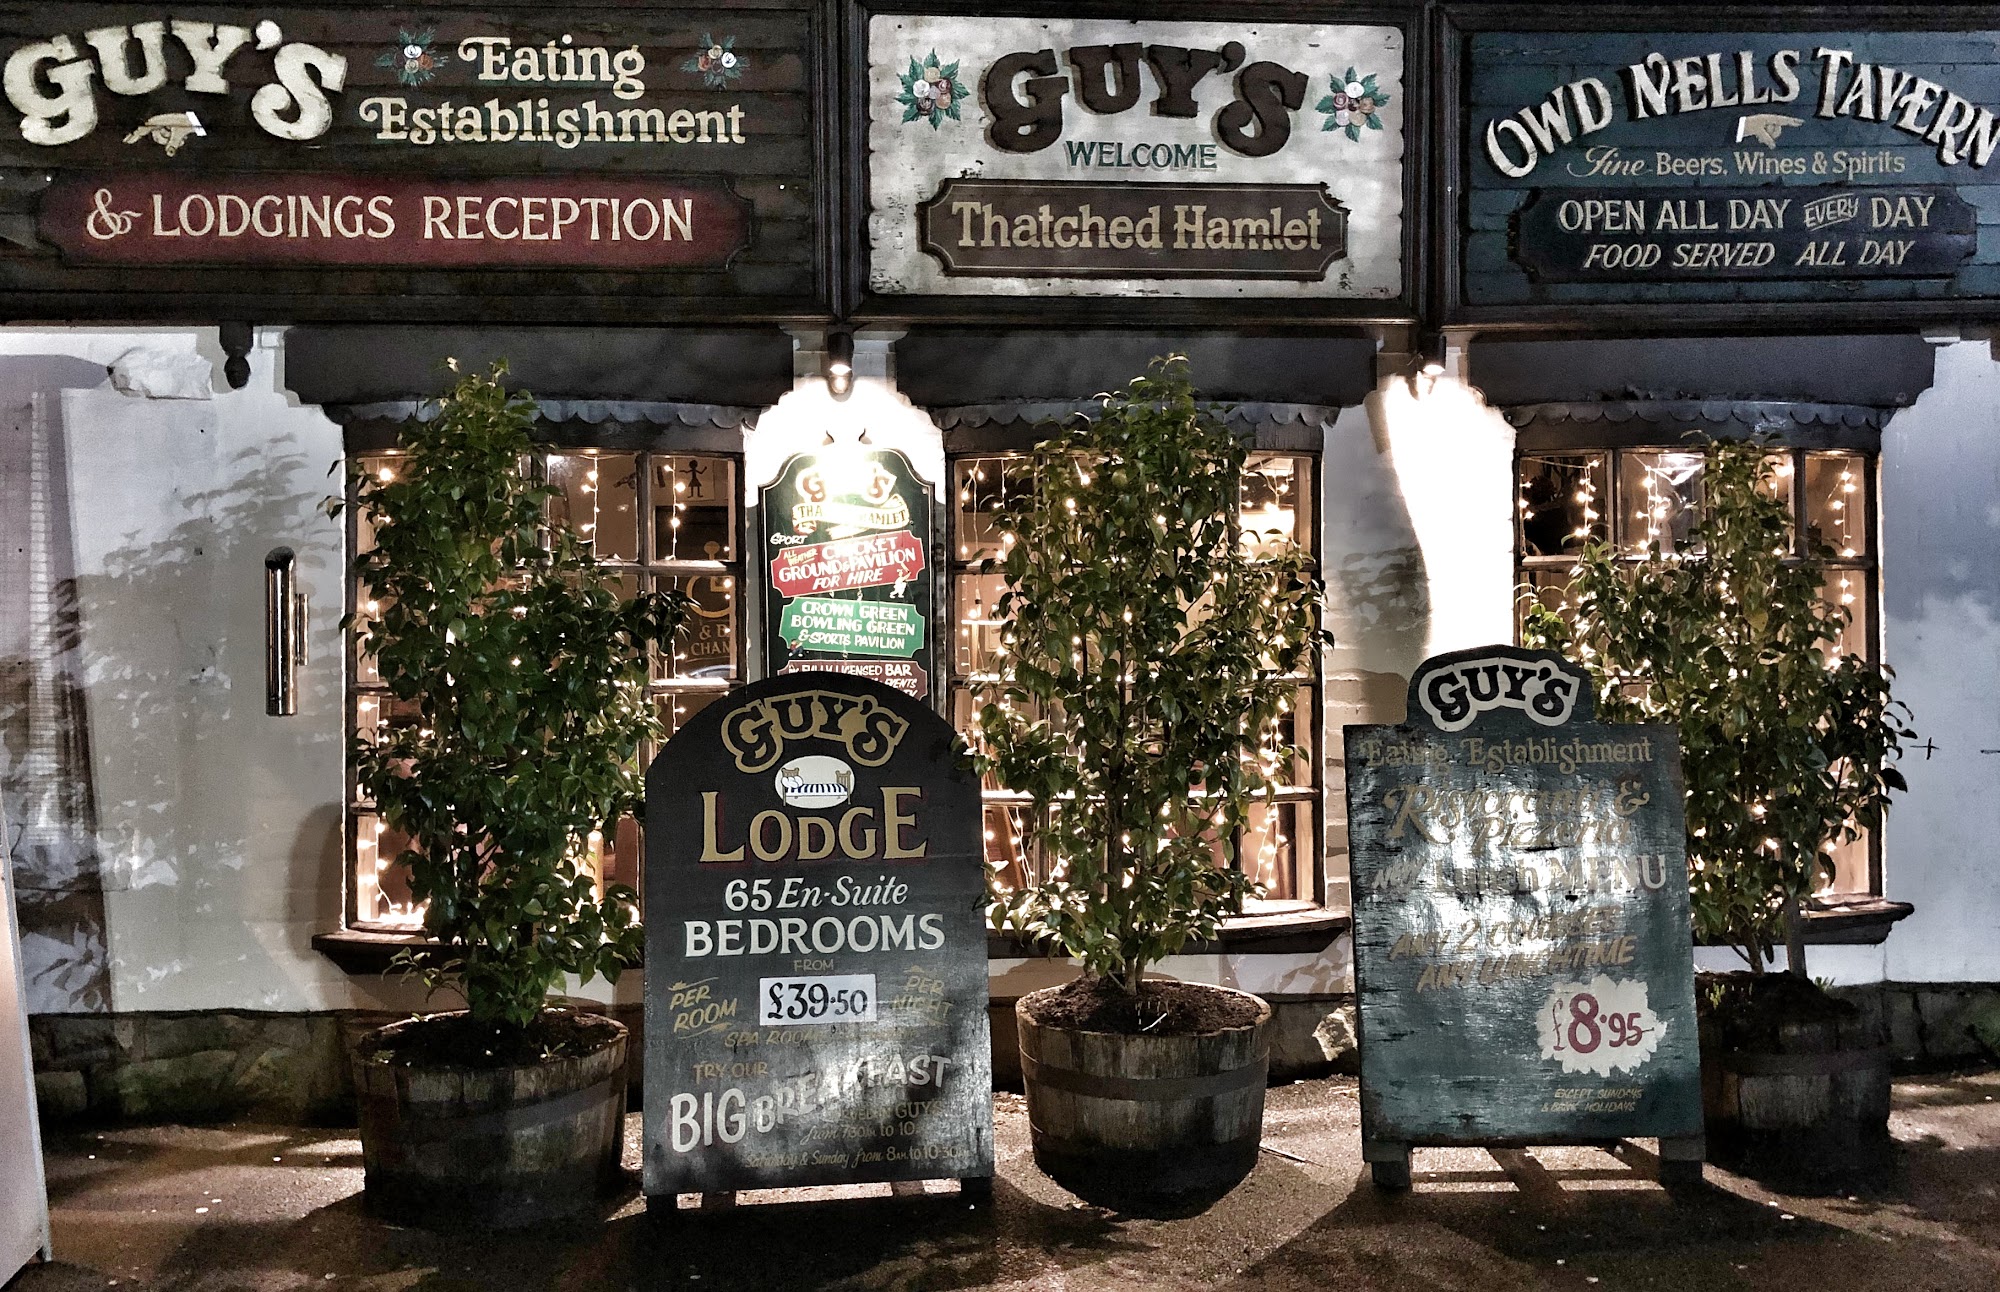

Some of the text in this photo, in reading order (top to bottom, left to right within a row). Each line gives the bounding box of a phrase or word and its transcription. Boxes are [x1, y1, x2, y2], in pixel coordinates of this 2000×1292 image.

[3, 19, 349, 146] GUY'S
[458, 36, 646, 100] Eating
[978, 41, 1309, 157] GUY'S
[1486, 46, 2000, 178] OWD NELLS TAVERN
[359, 97, 747, 149] Establishment
[1065, 140, 1217, 170] WELCOME
[1567, 145, 1653, 177] Fine
[1734, 151, 1806, 175] Wines
[1811, 152, 1828, 175] &
[1832, 151, 1905, 180] Spirits
[86, 189, 694, 242] & LODGINGS RECEPTION
[952, 201, 1321, 250] Thatched Hamlet
[1559, 196, 1935, 231] OPEN ALL DAY EVERY DAY
[1584, 239, 1915, 269] FOOD SERVED ALL DAY
[770, 532, 807, 545] SPORT
[779, 560, 842, 582] GROUND
[848, 547, 917, 572] PAVILION
[812, 568, 883, 590] FOR HIRE
[791, 615, 915, 636] BOWLING GREEN
[802, 601, 908, 621] CROWN GREEN
[809, 632, 851, 645] SPORTS
[855, 636, 905, 649] PAVILION
[885, 664, 912, 676] BAR
[1423, 660, 1577, 729] GUY'S
[724, 692, 906, 770] GUY'S
[1459, 737, 1653, 775] Establishment
[1614, 779, 1650, 816] &
[699, 786, 927, 863] LODGE
[1549, 855, 1666, 891] MENU
[724, 875, 908, 912] 65 En-Suite
[684, 914, 946, 958] BEDROOMS
[1455, 919, 1480, 953] 2
[794, 959, 834, 971] FROM
[1416, 957, 1477, 994] ANY
[670, 985, 711, 1010] PER
[906, 975, 944, 996] PER
[674, 998, 738, 1032] ROOM
[725, 1032, 759, 1047] SPA
[693, 1060, 769, 1082] TRY OUR
[1554, 1088, 1593, 1099] EXCEPT
[1584, 1101, 1636, 1112] HOLIDAYS
[669, 1087, 747, 1152] BIG
[880, 1123, 894, 1137] to
[812, 1150, 850, 1169] Sunday
[851, 1149, 884, 1169] from
[909, 1147, 920, 1161] to
